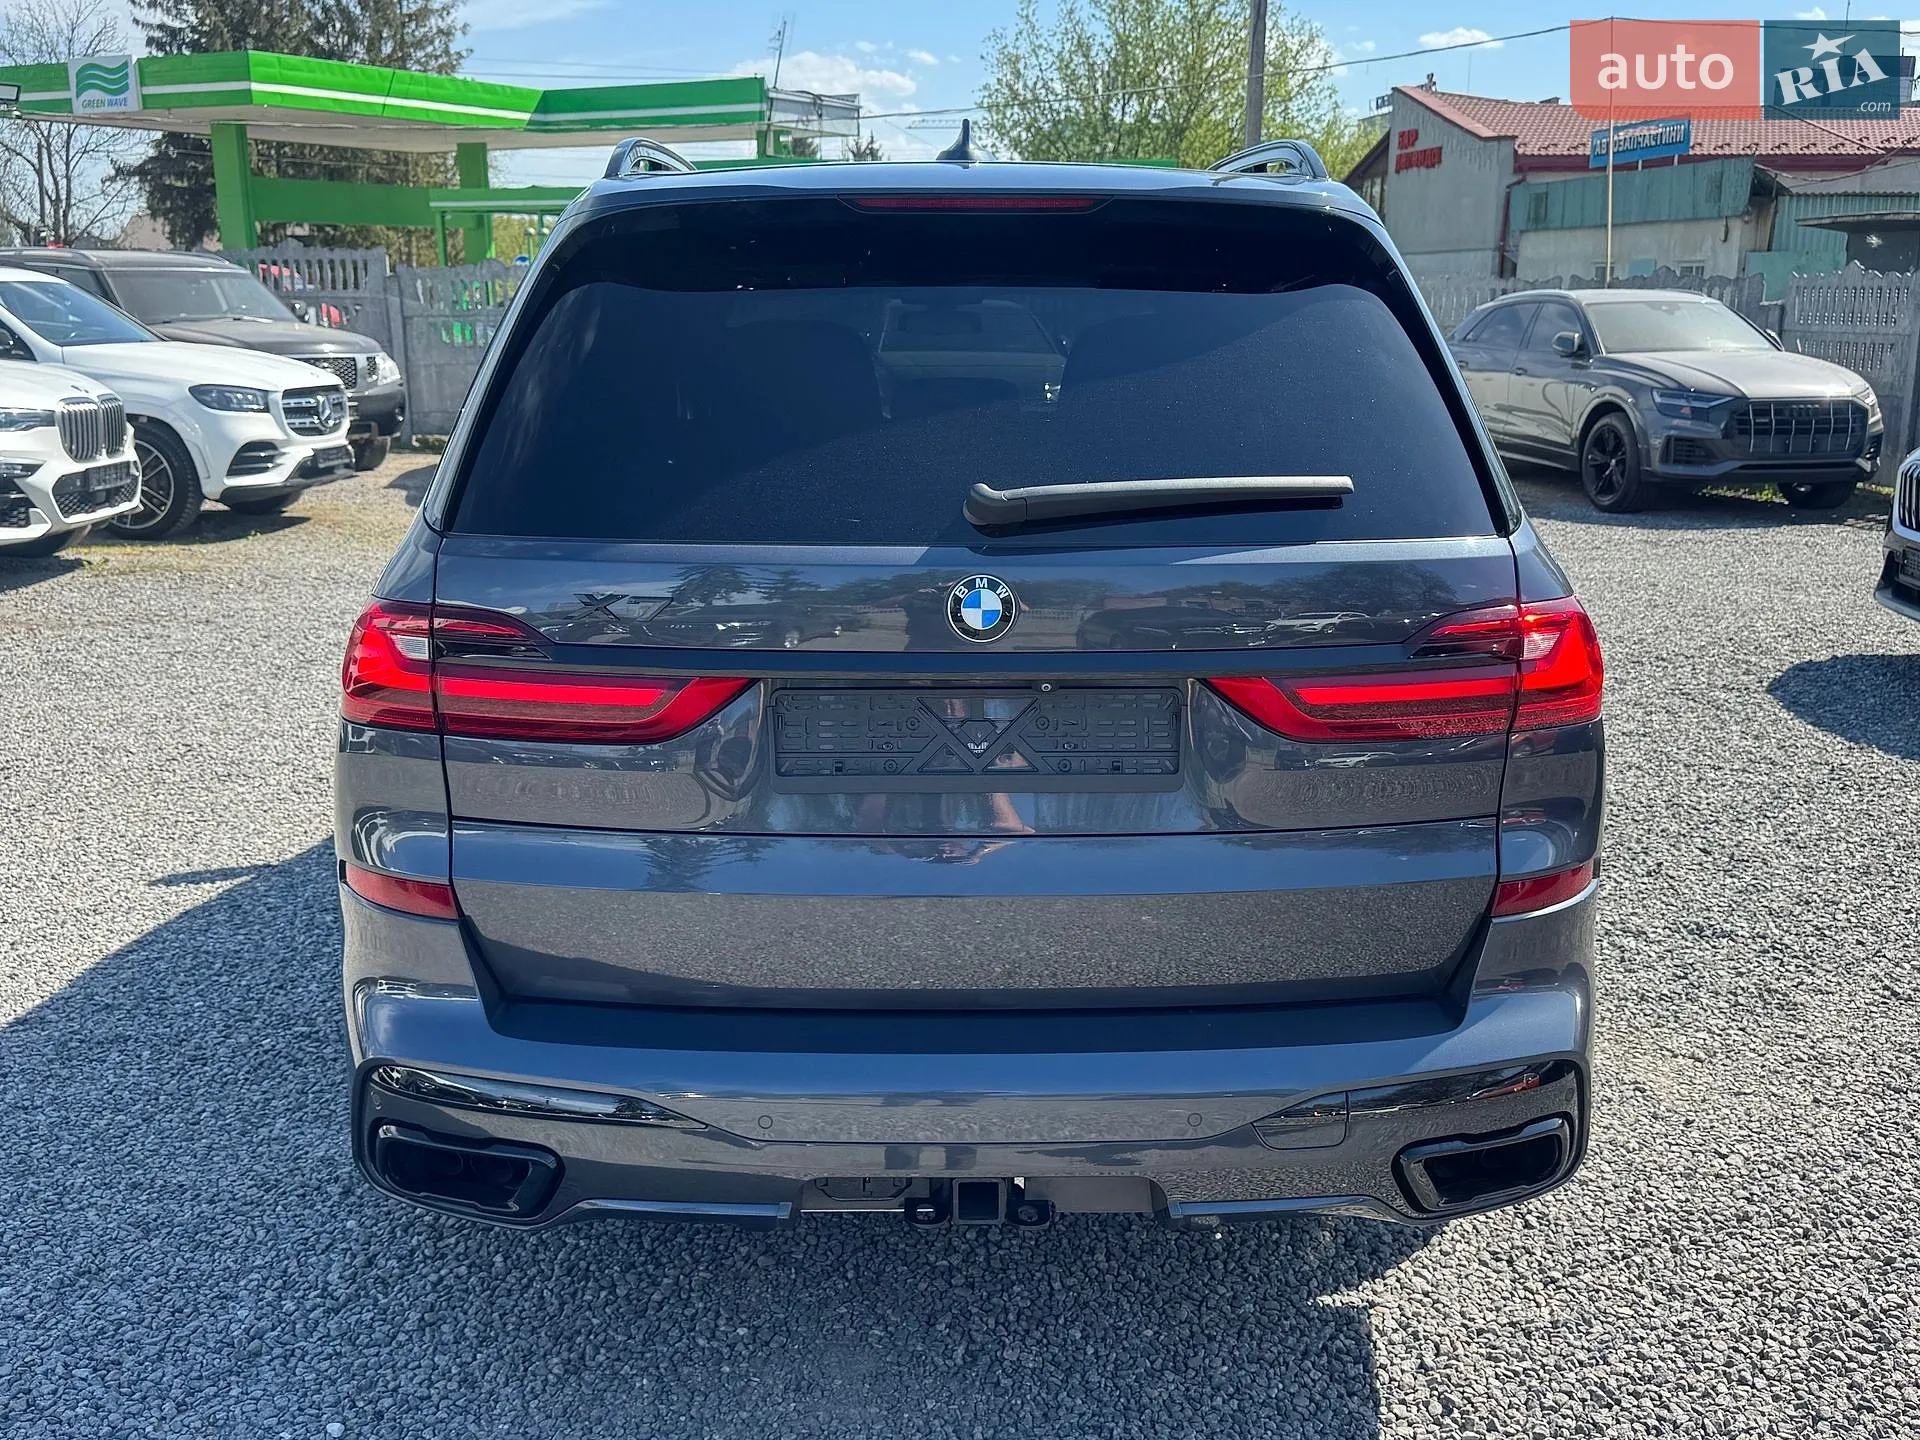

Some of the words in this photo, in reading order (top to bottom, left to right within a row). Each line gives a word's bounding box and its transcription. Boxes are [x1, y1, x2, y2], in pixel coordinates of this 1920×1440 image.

[82, 98, 106, 109] GREEN
[107, 96, 129, 108] WAVE
[955, 577, 1009, 599] BMW
[564, 592, 674, 622] X7
